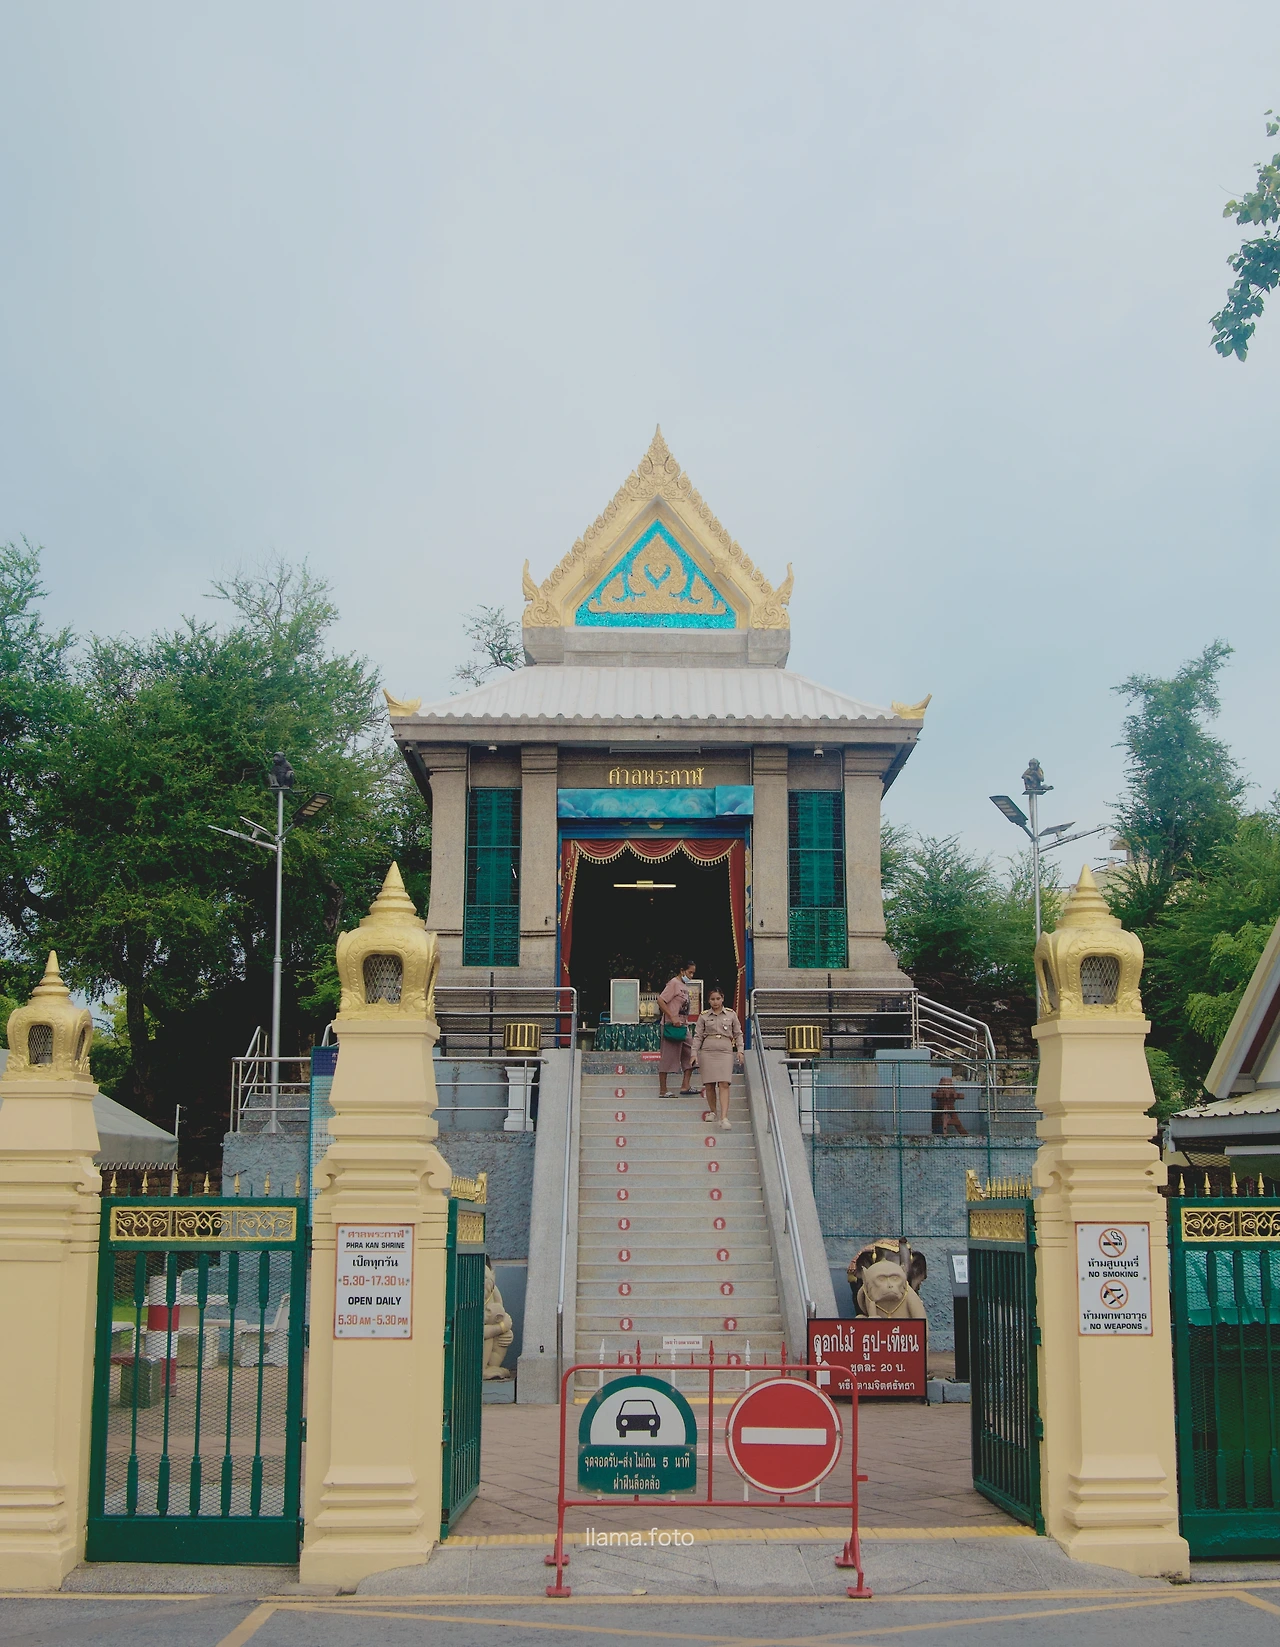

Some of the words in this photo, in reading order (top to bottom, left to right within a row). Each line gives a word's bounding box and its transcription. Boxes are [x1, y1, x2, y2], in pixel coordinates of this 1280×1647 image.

[609, 767, 704, 785] ศาลพระกาฬ
[352, 1255, 398, 1269] เปิดทุกวัน
[1088, 1255, 1139, 1269] ห้ามสูบบุหรี่
[348, 1296, 372, 1305] OPEN
[376, 1296, 402, 1305] DAILY
[338, 1315, 357, 1325] 5.30
[397, 1317, 408, 1325] PM
[1083, 1310, 1147, 1322] ห้ามพกพาอาวุธ
[863, 1326, 919, 1360] ธูป-เทียน
[850, 1363, 876, 1376] ชุดละ
[880, 1363, 893, 1372] 20
[895, 1363, 906, 1372] บ.
[662, 1457, 669, 1468] 5
[675, 1452, 690, 1468] นาที
